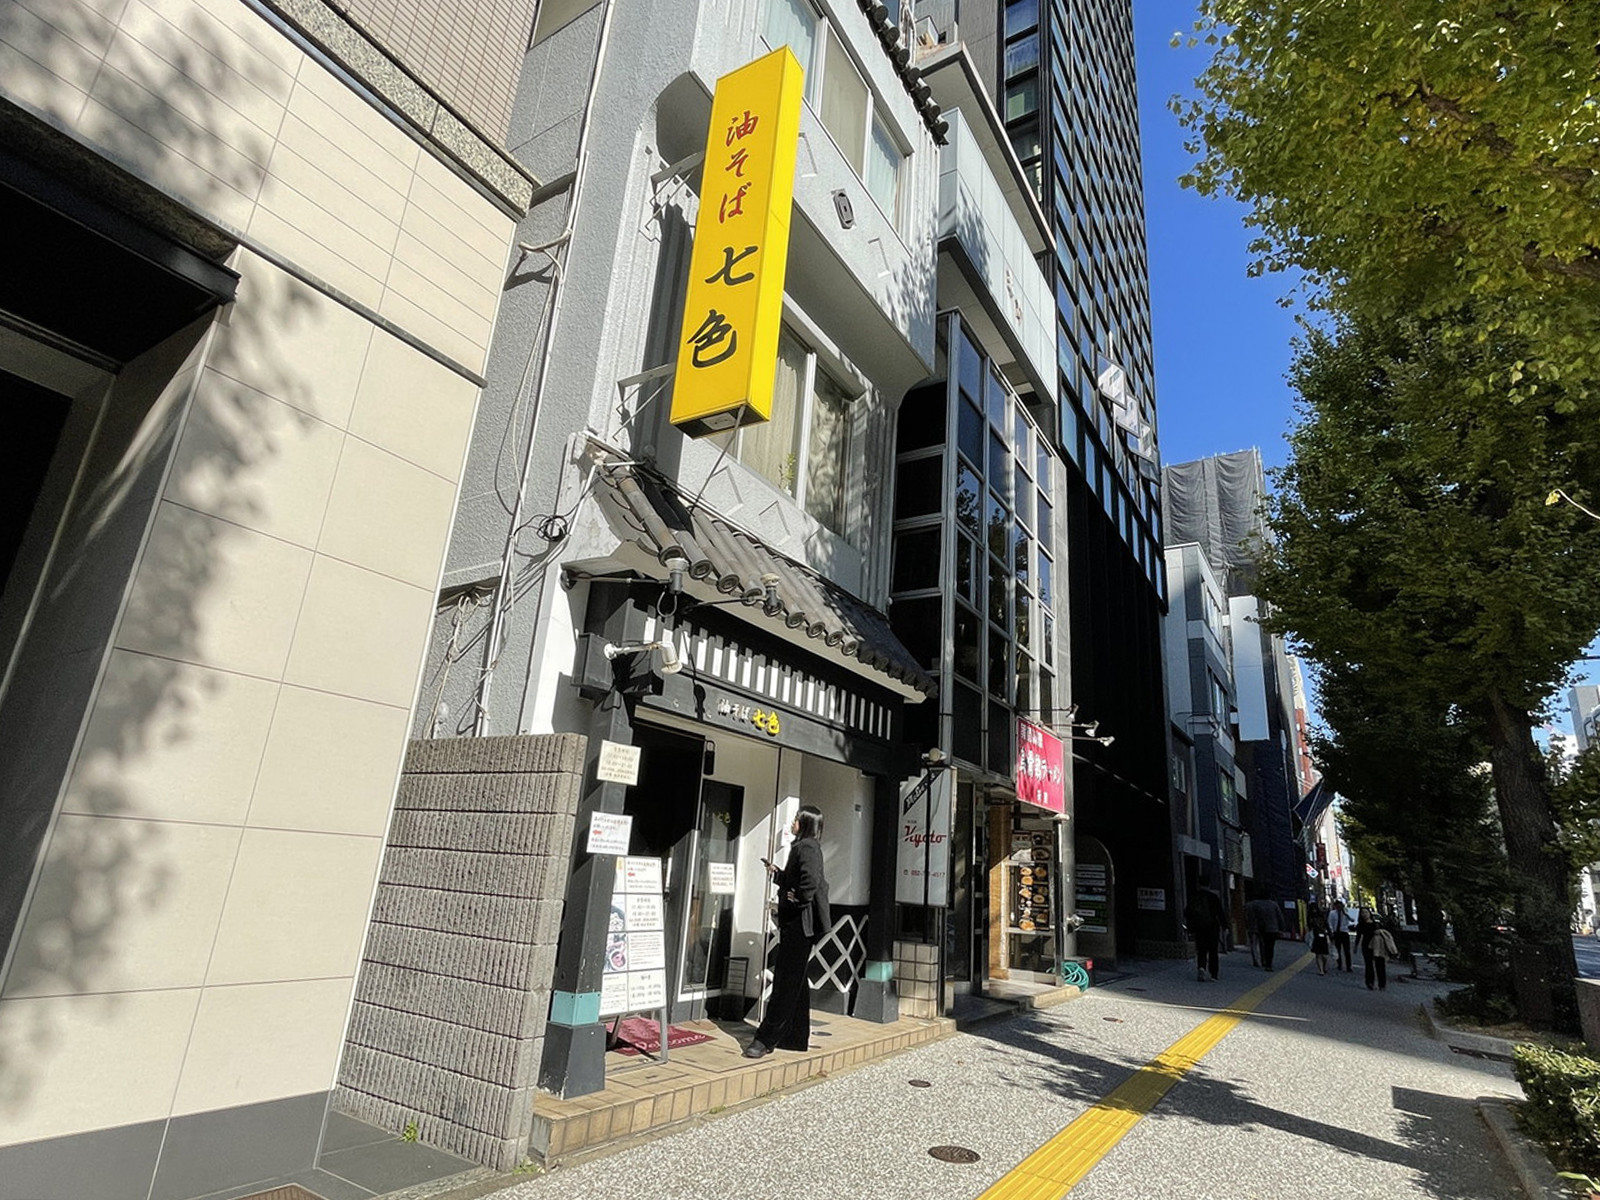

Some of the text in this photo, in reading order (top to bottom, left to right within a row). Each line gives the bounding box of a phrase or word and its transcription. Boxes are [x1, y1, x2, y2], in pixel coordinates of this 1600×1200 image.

[687, 110, 759, 369] 油そば 七色
[718, 698, 780, 734] 油そば 七色
[904, 825, 947, 848] Kyoto
